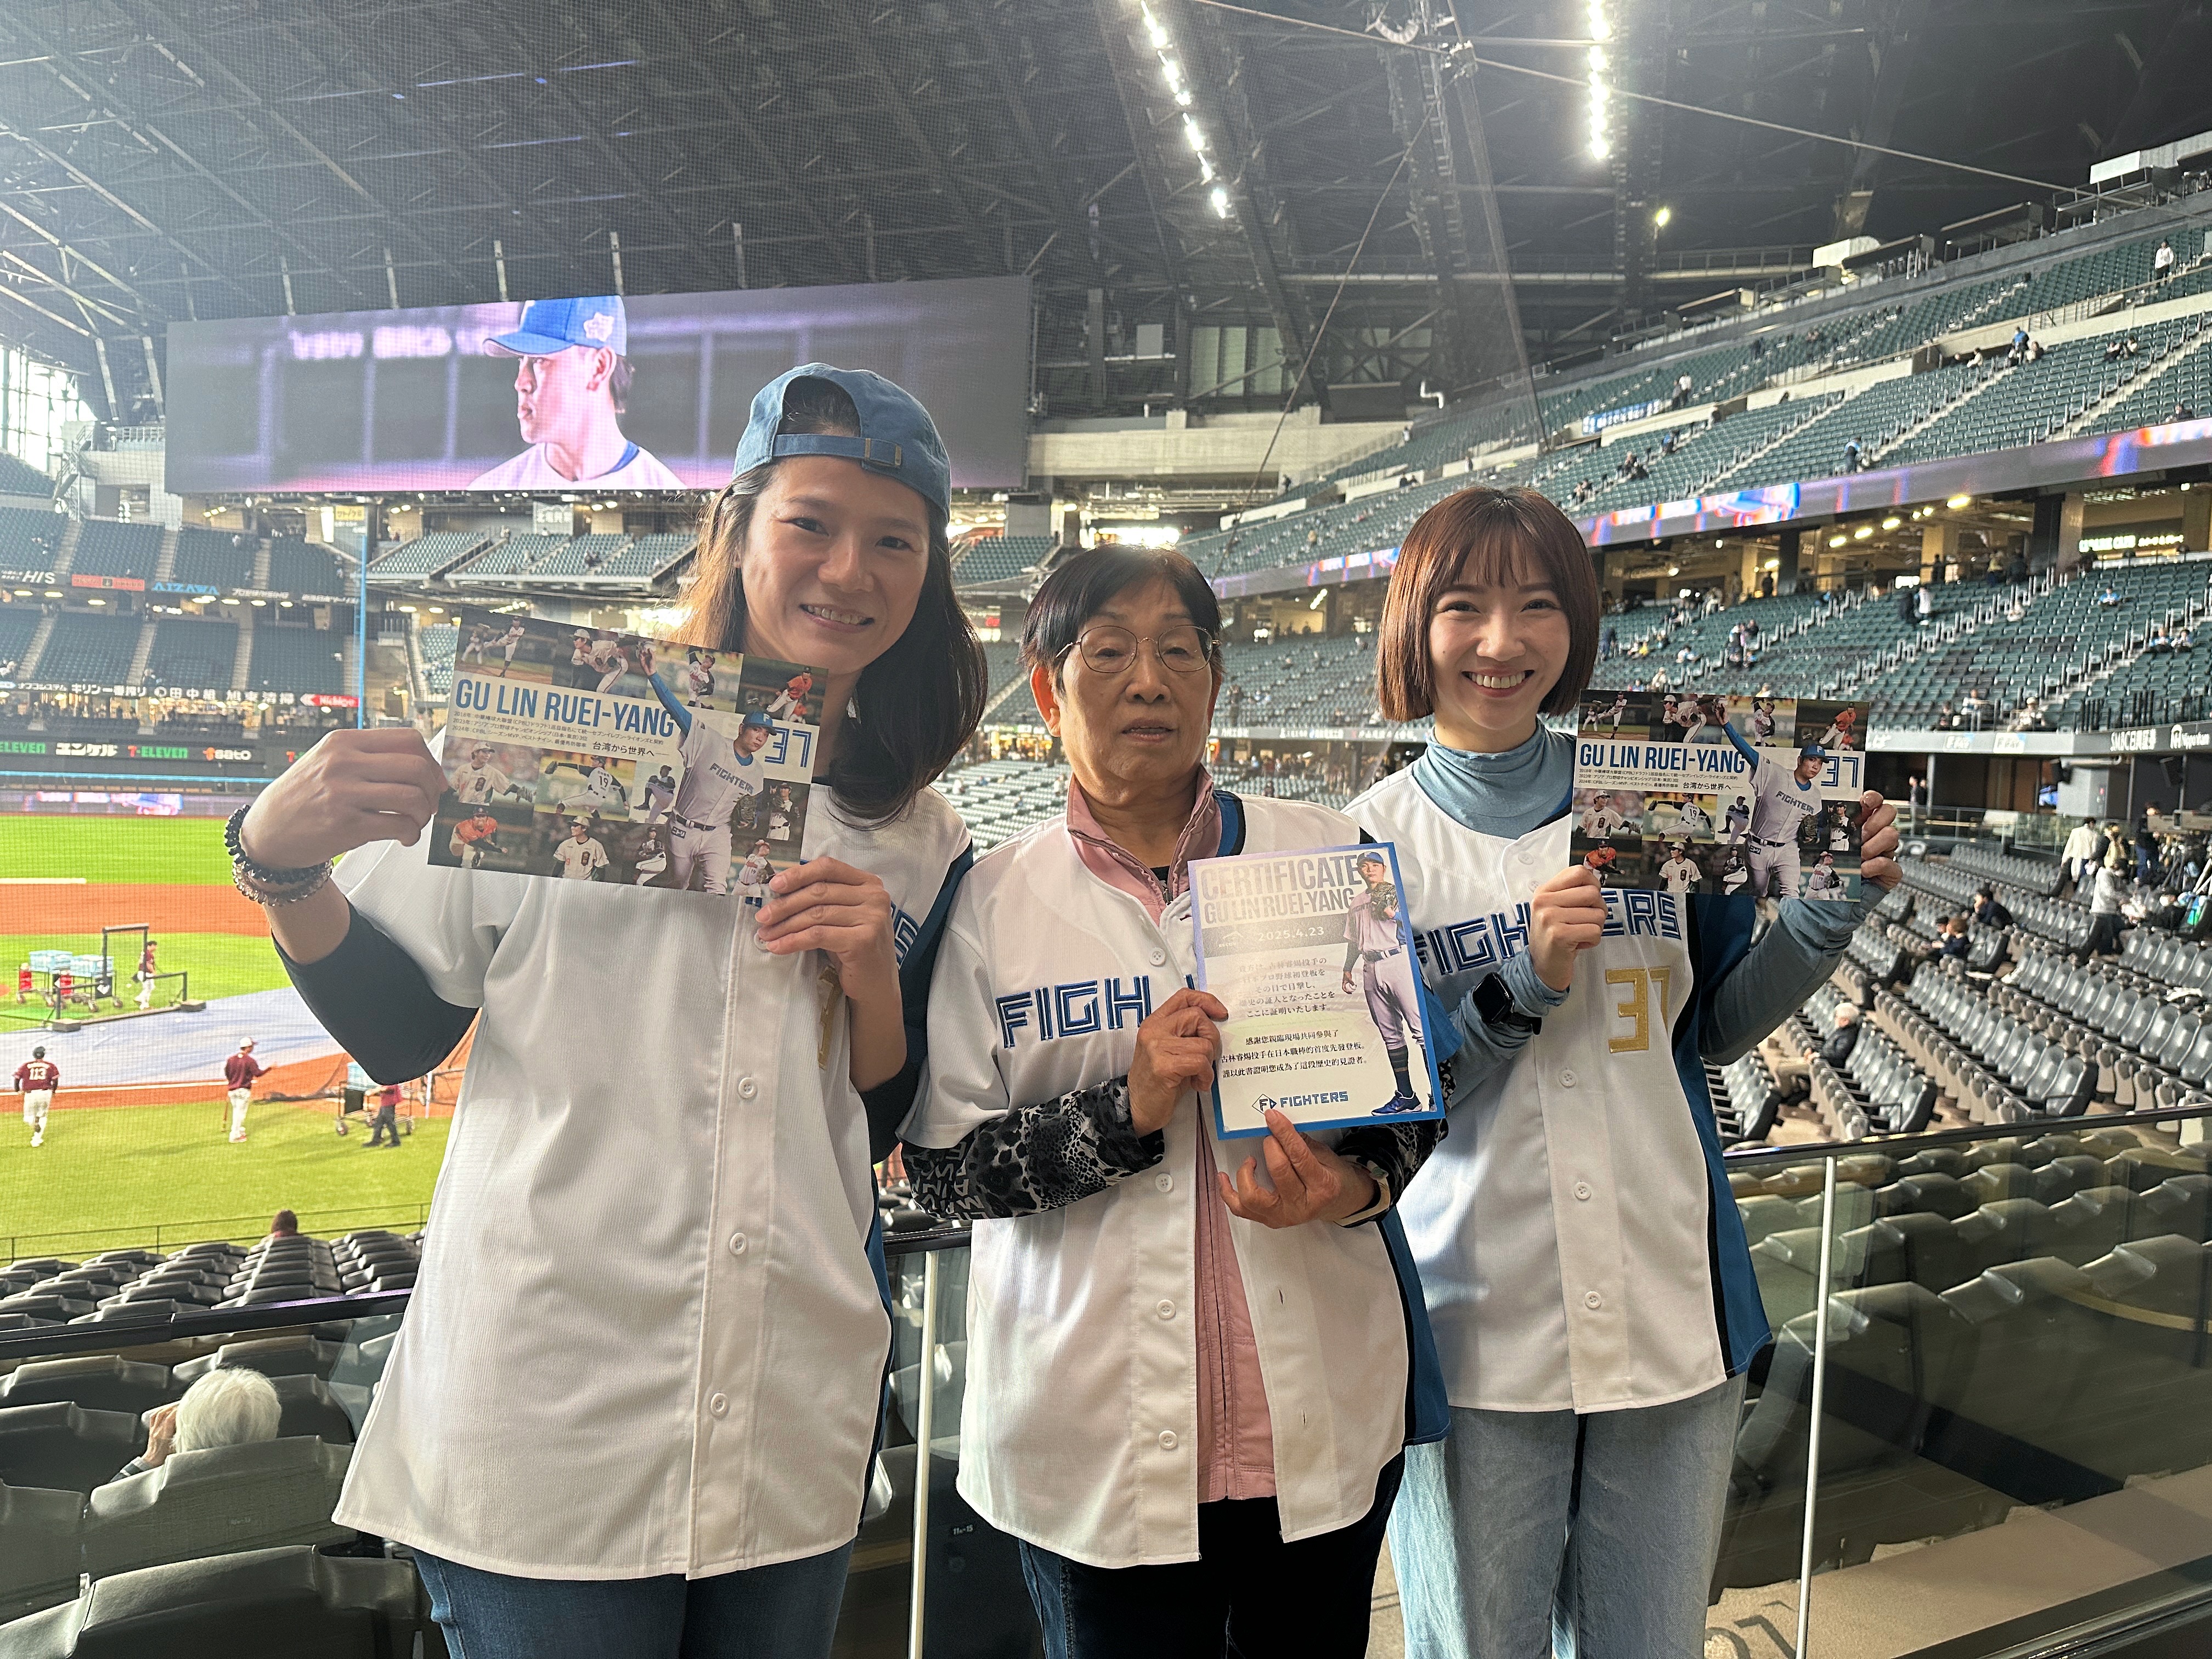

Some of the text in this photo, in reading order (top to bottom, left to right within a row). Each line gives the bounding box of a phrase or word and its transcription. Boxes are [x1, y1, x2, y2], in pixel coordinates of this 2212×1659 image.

[152, 582, 219, 595] AIZAWA
[71, 684, 147, 697] キリン一番搾り
[170, 687, 216, 701] 田中組
[456, 679, 675, 737] GU LIN RUEI-YANG
[765, 726, 812, 768] 37
[1580, 744, 1745, 774] GU LIN RUEI-YANG
[1821, 755, 1859, 788] 37
[599, 776, 608, 787] 19
[1690, 808, 1696, 817] 19
[673, 827, 685, 838] ニトリ
[1201, 854, 1362, 900] CERTIFICATE
[1204, 888, 1355, 924] GU LIN RUEI-YANG
[1258, 927, 1325, 941] 2025.4.23
[1247, 1003, 1331, 1018] ここに証明いたします。
[1280, 1091, 1348, 1108] FIGHTERS
